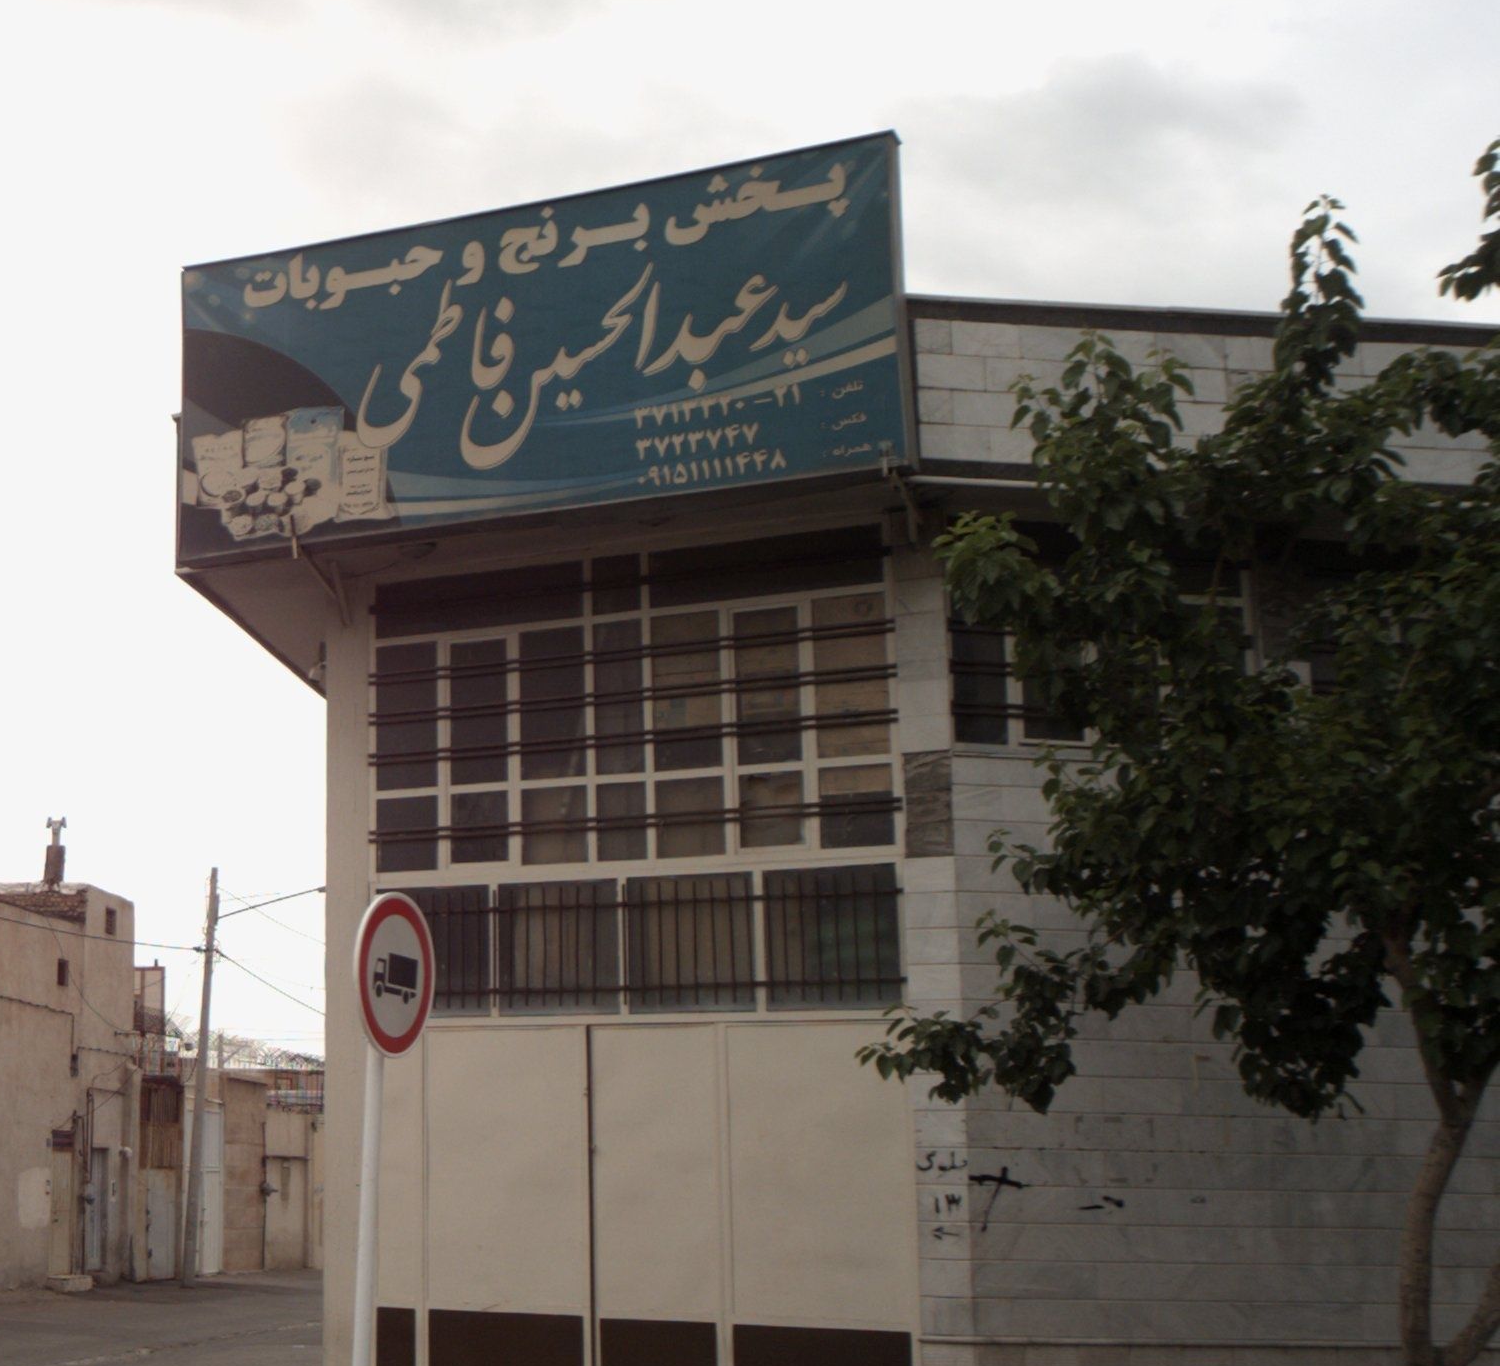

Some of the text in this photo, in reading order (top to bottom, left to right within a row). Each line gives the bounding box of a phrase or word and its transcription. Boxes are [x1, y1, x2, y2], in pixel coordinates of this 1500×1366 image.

[243, 161, 848, 310] پخش برنج و حبوبات
[356, 279, 514, 449] فاطمی
[750, 280, 848, 367] سید
[637, 448, 787, 486] ۰۹۱۵۱۱۱۱۴۴۸
